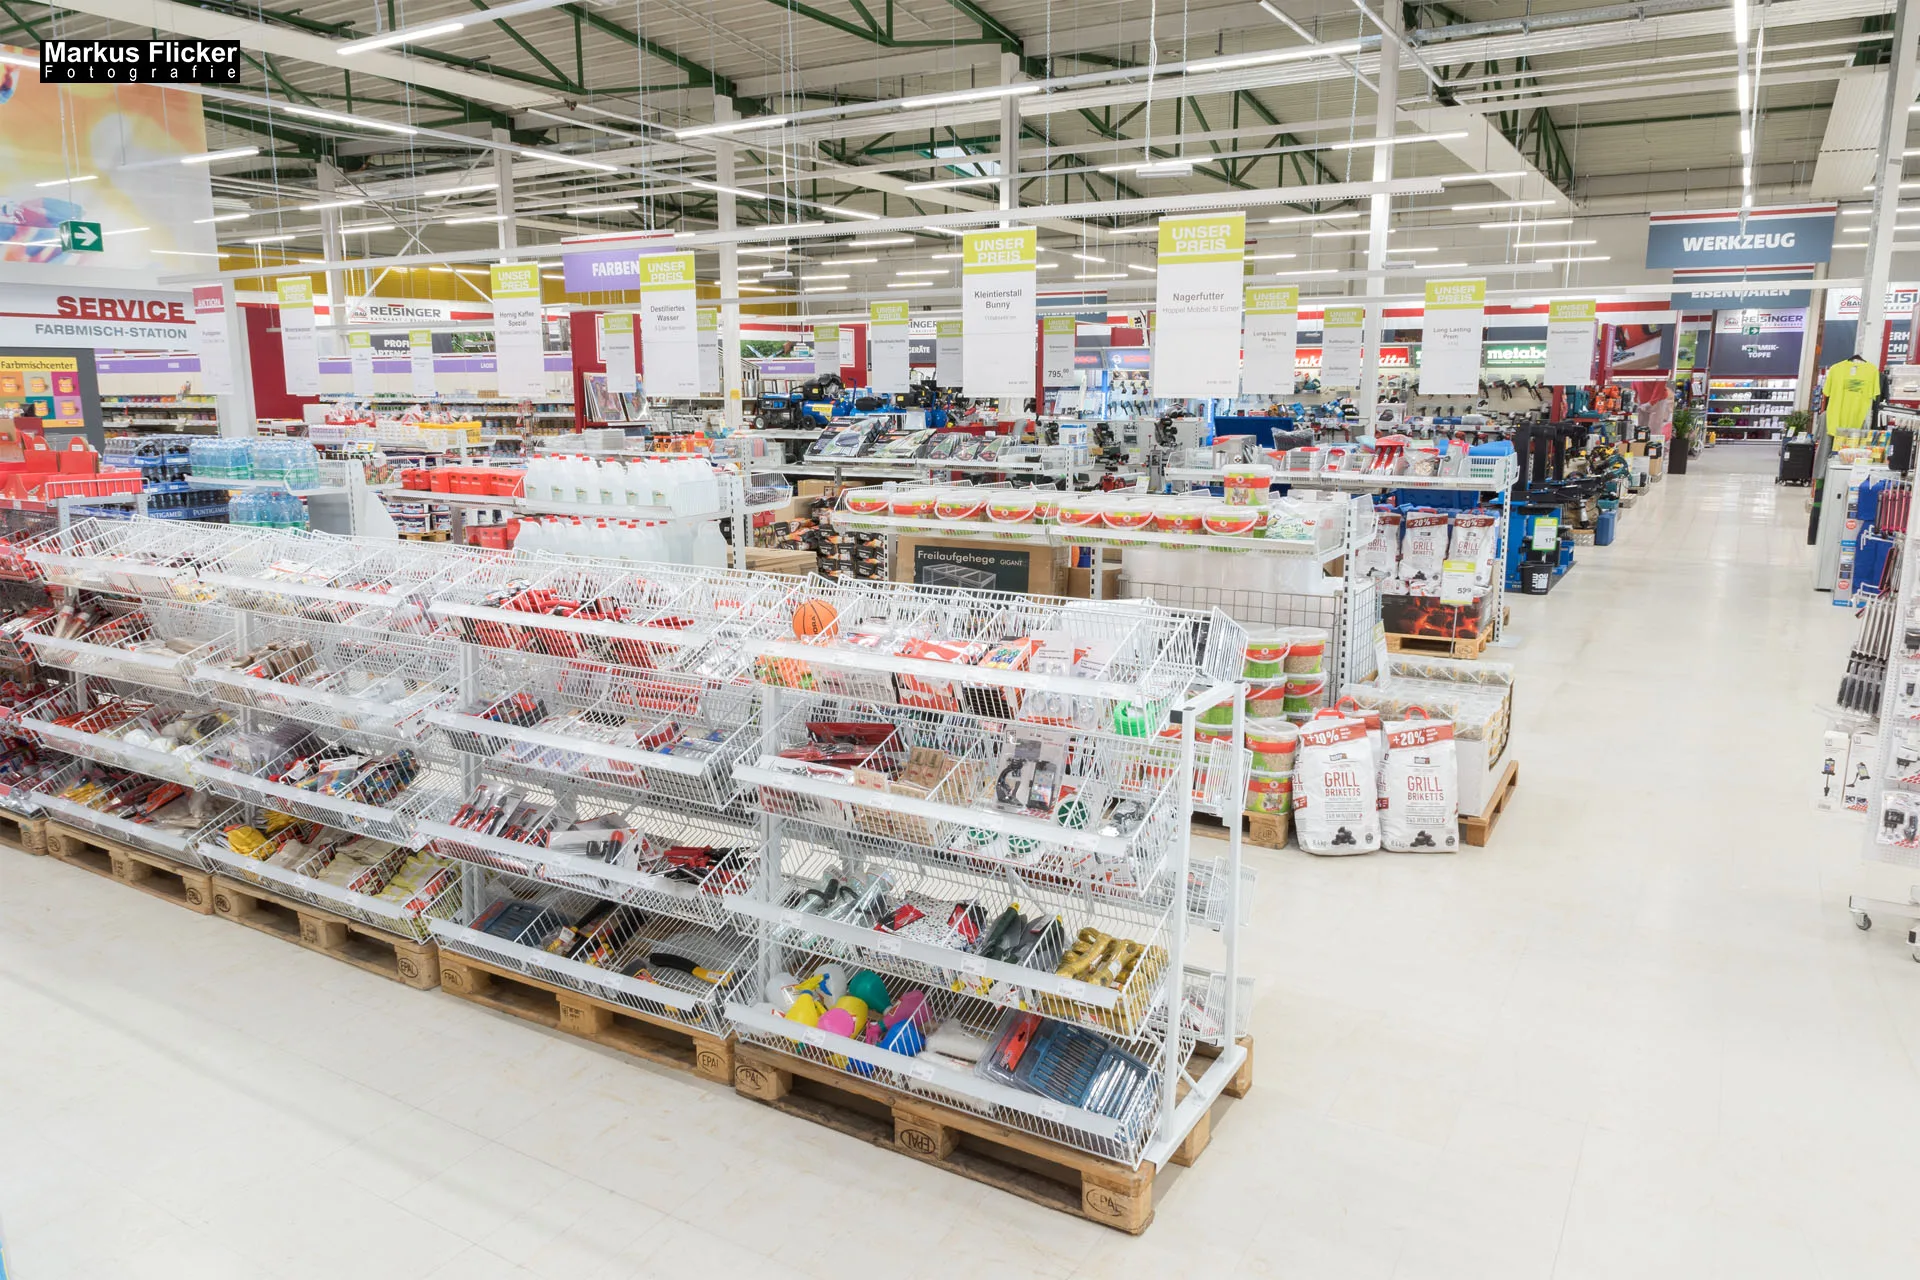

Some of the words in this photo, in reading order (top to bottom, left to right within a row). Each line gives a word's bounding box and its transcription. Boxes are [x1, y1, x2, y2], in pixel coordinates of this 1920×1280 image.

[1171, 224, 1231, 240] UNSER
[974, 238, 1025, 252] UNSER
[1175, 238, 1227, 253] PREIS
[1683, 232, 1796, 252] WERKZEUG
[978, 251, 1022, 264] PREIS
[592, 261, 640, 277] FARBEN
[648, 261, 686, 272] UNSER
[498, 270, 531, 281] UNSER
[650, 272, 684, 283] PREIS
[501, 280, 530, 290] PREIS
[1434, 285, 1475, 295] UNSER
[974, 288, 1022, 299] Kleintierstall
[1173, 291, 1225, 303] Nagerfutter
[1253, 291, 1290, 301] UNSER
[1437, 294, 1472, 303] PREIS
[56, 295, 185, 321] SERVICE
[985, 301, 1011, 310] Bunny
[370, 305, 441, 318] REISINGER
[1741, 315, 1803, 323] REISINGER
[35, 323, 188, 339] FARBMISCH-STATION
[0, 361, 74, 370] Farbmischcenter
[1413, 541, 1434, 551] GRILL
[917, 550, 996, 566] Freilaufgehege
[1000, 559, 1023, 567] GIGANT
[1392, 731, 1425, 746] +20%
[1324, 771, 1360, 788] GRILL
[1407, 775, 1444, 792] GRILL
[1325, 788, 1361, 797] BRIKETTS
[1407, 793, 1444, 801] BRIKETTS
